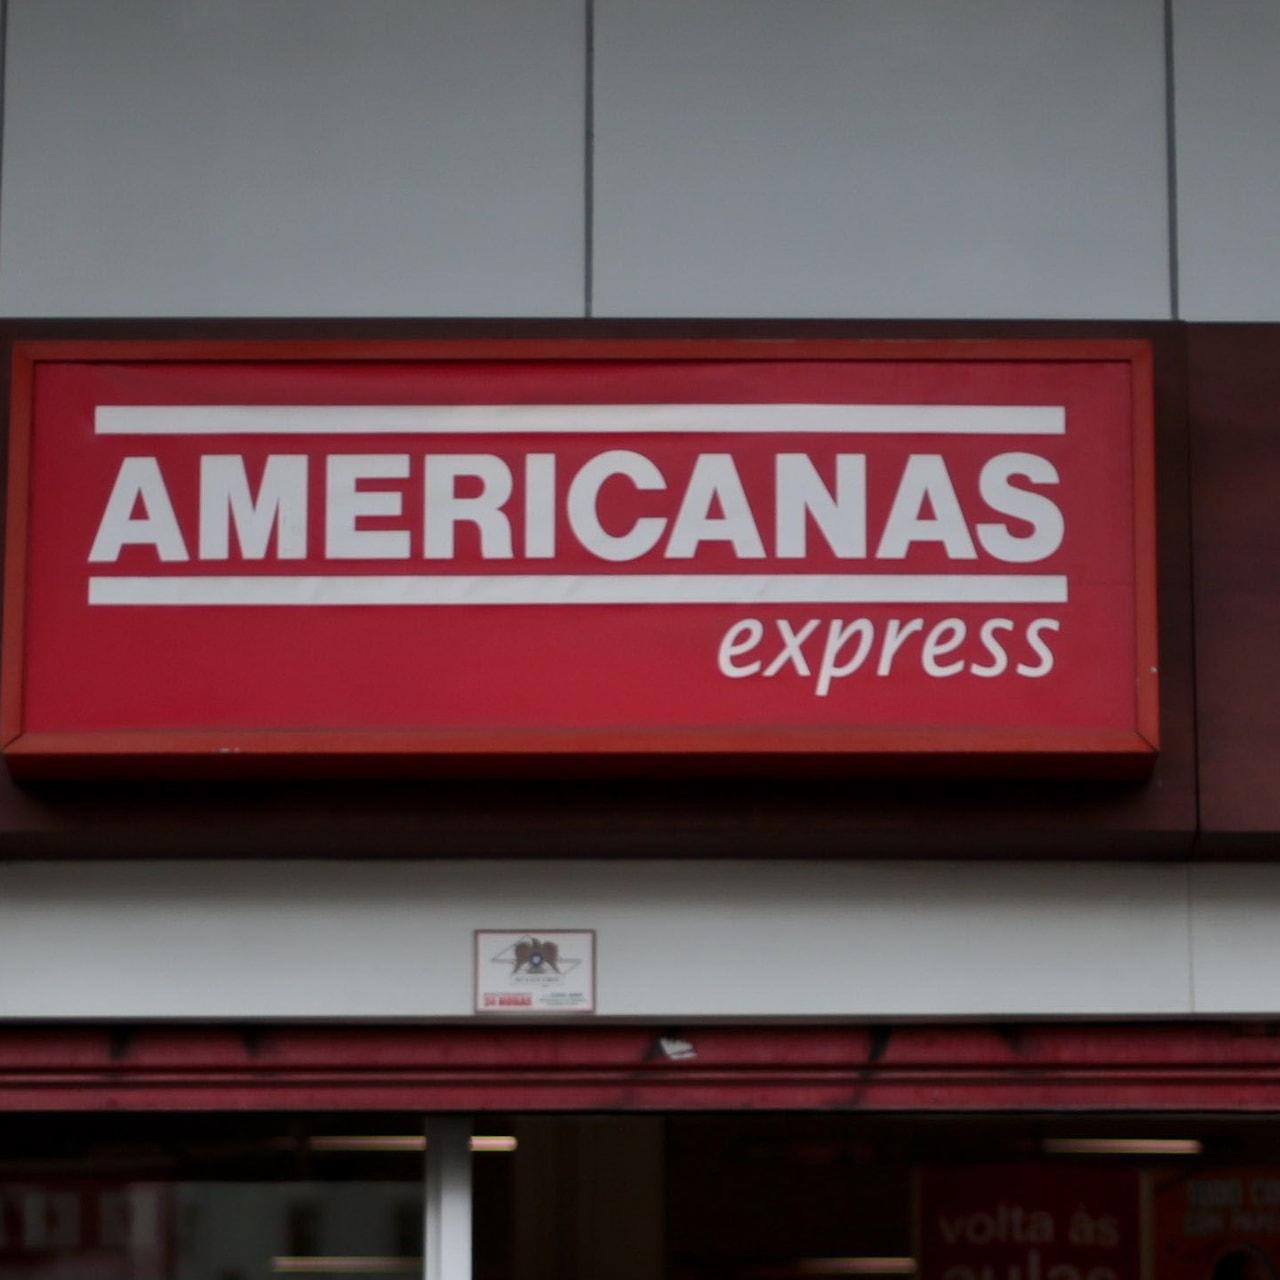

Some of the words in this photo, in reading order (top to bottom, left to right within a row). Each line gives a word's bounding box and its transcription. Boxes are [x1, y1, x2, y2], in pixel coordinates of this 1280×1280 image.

[87, 449, 1066, 563] AMERICANAS
[716, 616, 1063, 697] express
[938, 1200, 1056, 1246] volta
